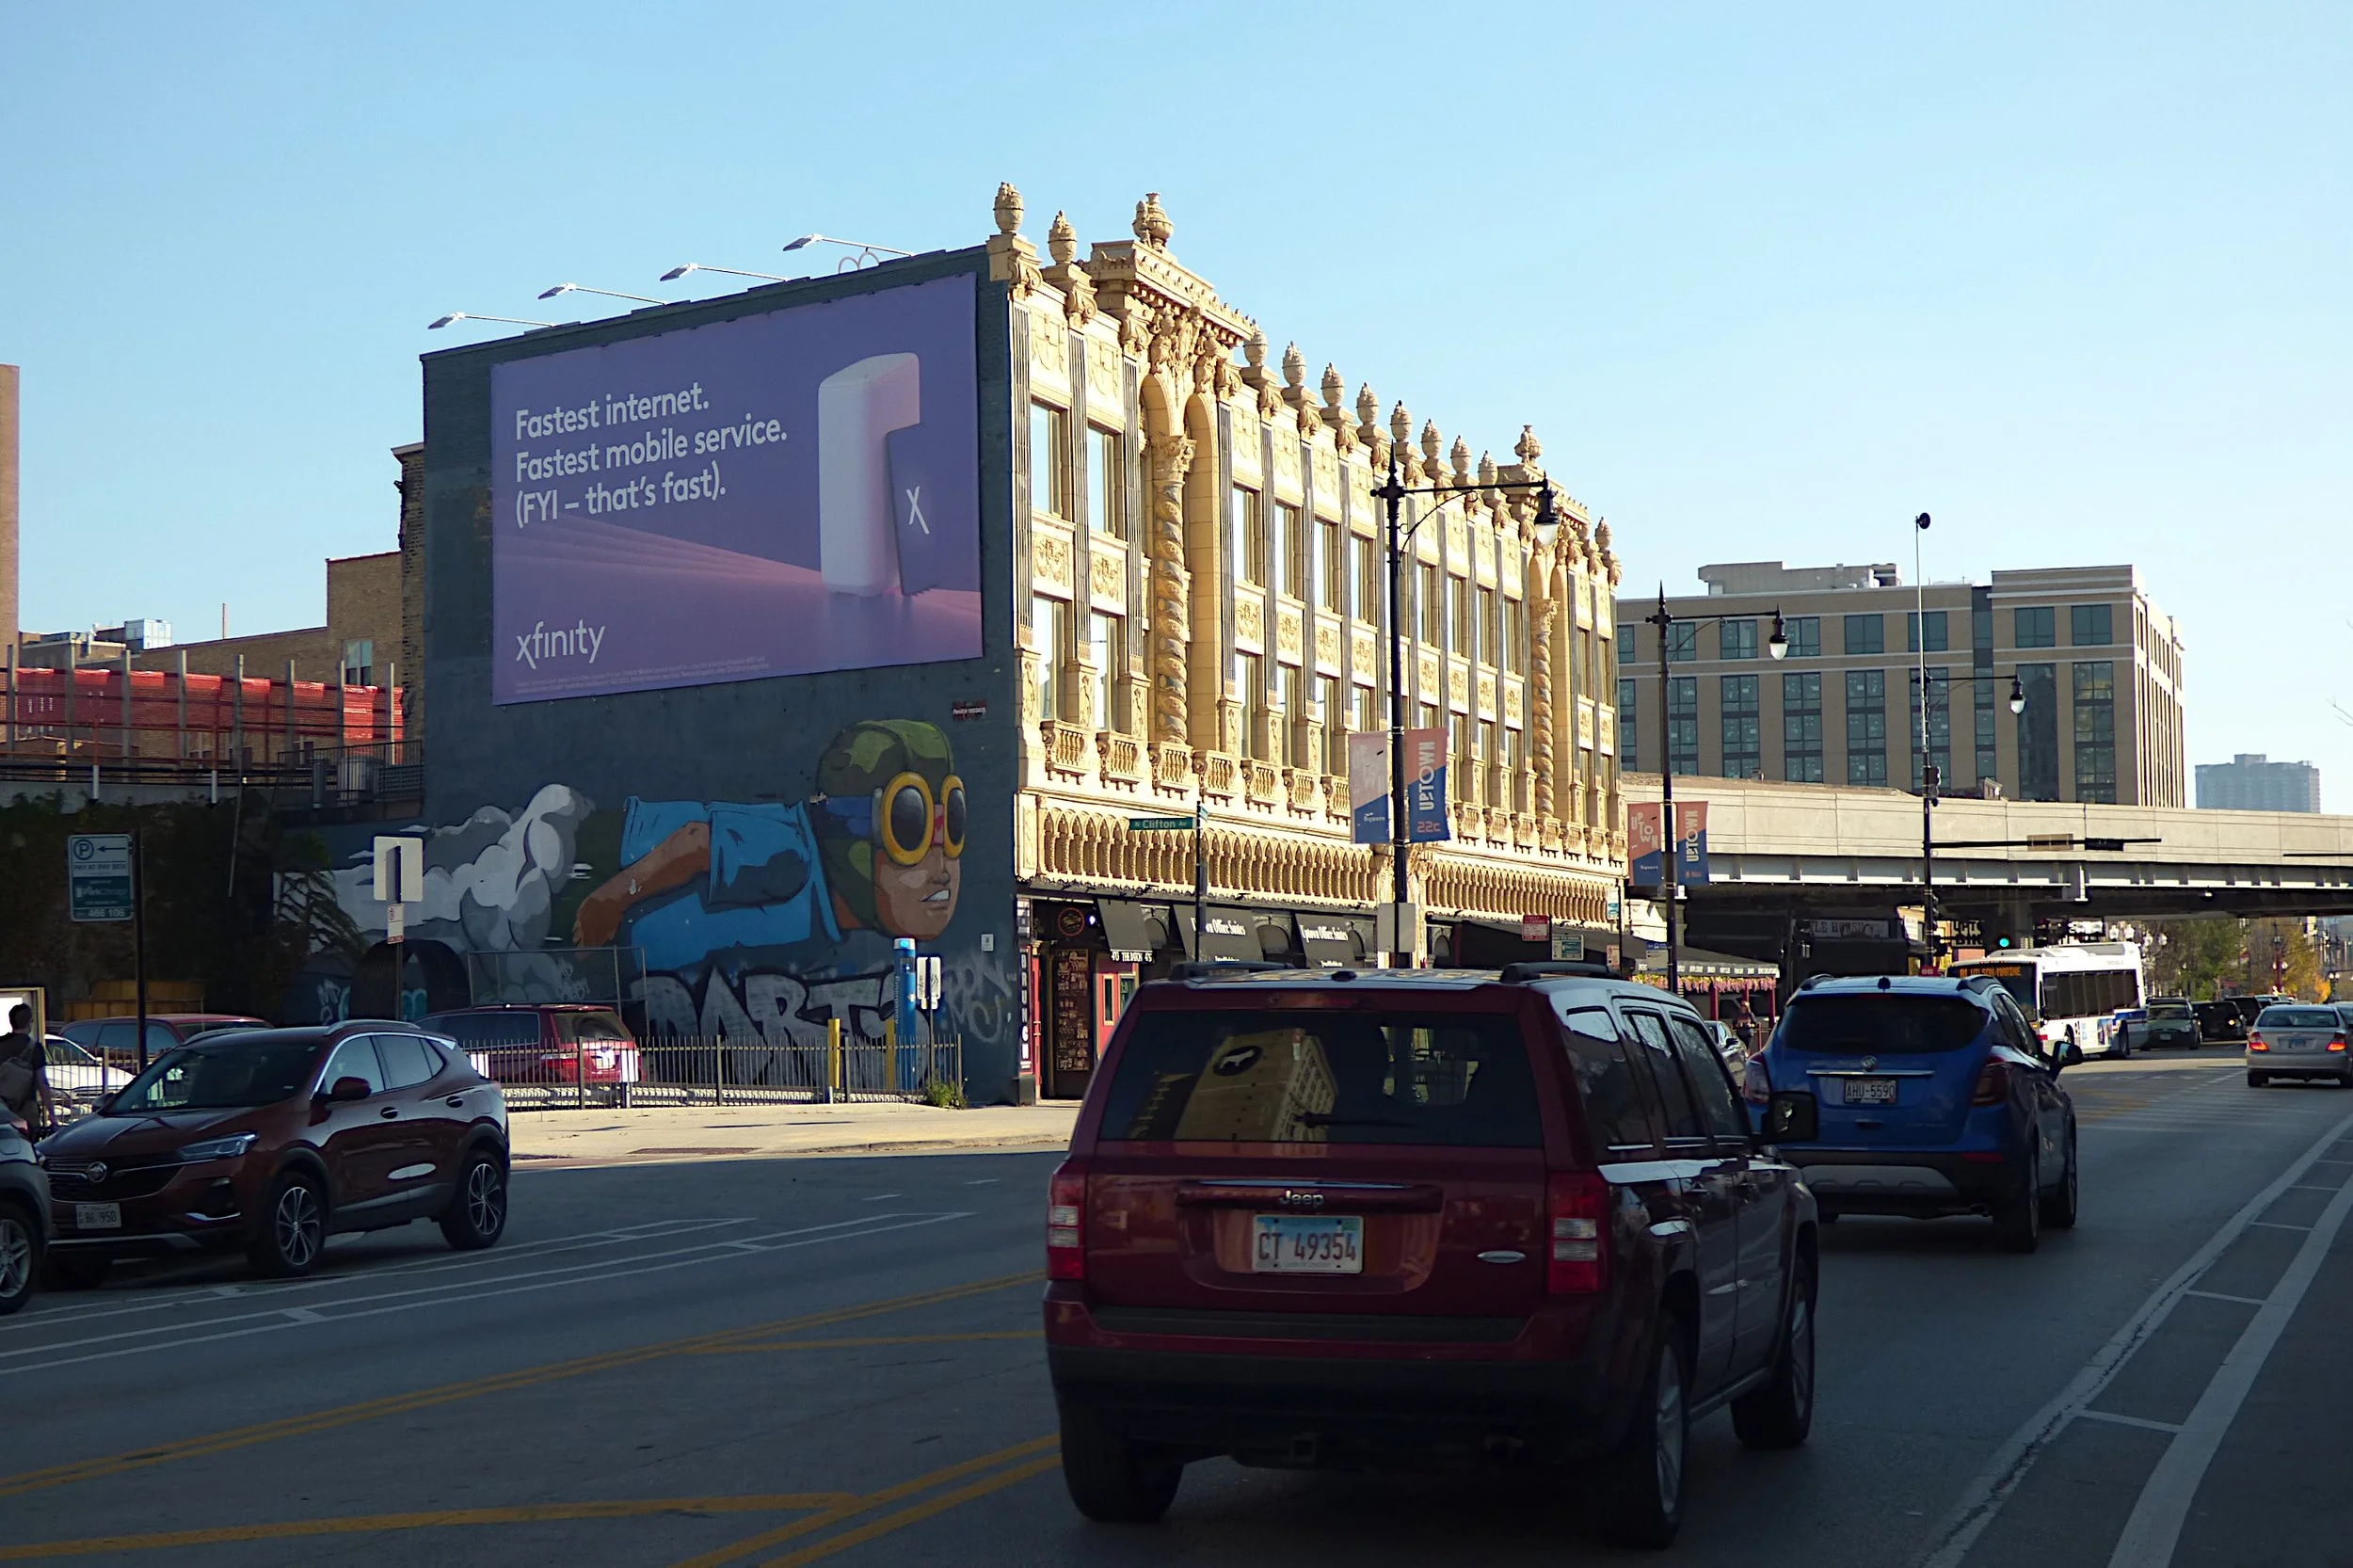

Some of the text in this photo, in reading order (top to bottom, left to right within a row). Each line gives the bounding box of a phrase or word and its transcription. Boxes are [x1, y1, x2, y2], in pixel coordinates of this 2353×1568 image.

[516, 381, 710, 440] Fastest internet.
[516, 412, 788, 483] Fastest mobile service.
[516, 488, 558, 529] (FYI
[661, 460, 727, 504] fast).
[516, 618, 606, 670] xfinity
[1418, 742, 1435, 810] UPTOWN
[1143, 819, 1176, 829] Clifton
[1685, 810, 1699, 862] UPTOWN
[1020, 954, 1030, 1060] BRUNCH
[1847, 1084, 1896, 1097] AHU-5590
[1280, 1190, 1324, 1207] Jeep
[1258, 1232, 1356, 1261] CT 49354
